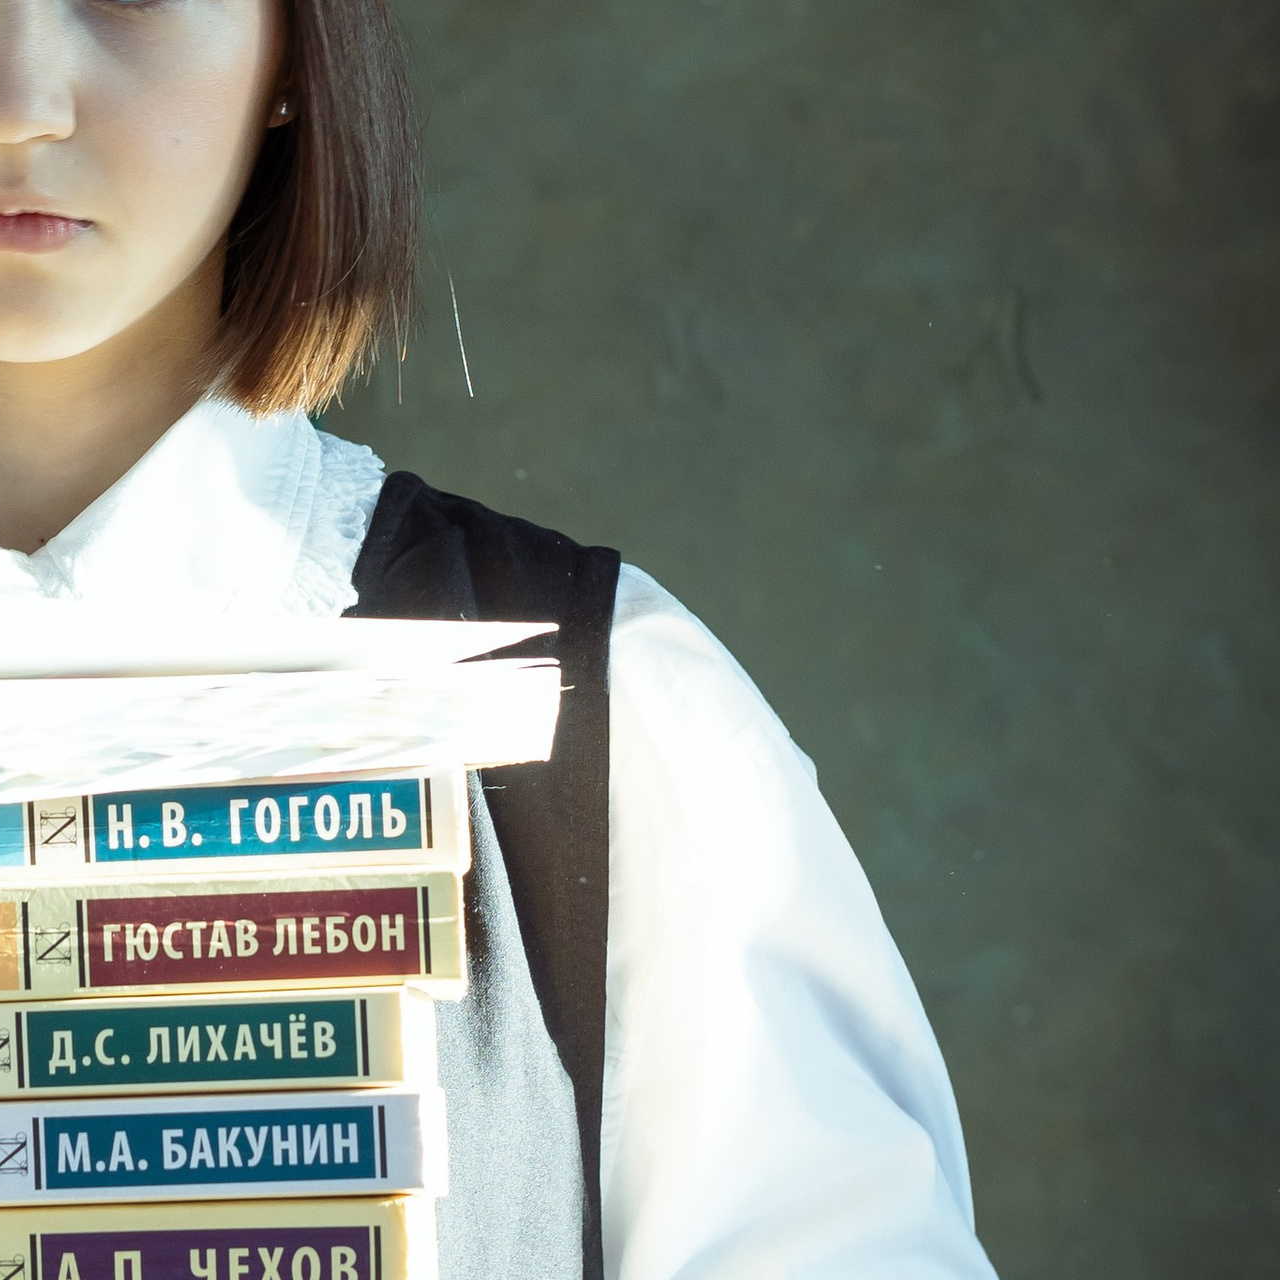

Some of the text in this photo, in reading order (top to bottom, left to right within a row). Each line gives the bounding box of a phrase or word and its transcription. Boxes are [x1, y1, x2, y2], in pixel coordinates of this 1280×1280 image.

[229, 792, 406, 844] ГОГОЛЬ
[103, 913, 406, 962] ГЮСТАВ ЛЕБОН
[49, 1014, 337, 1075] Д.С. ЛИХАЧЁВ
[57, 1122, 359, 1174] М.А. БАКУНИН
